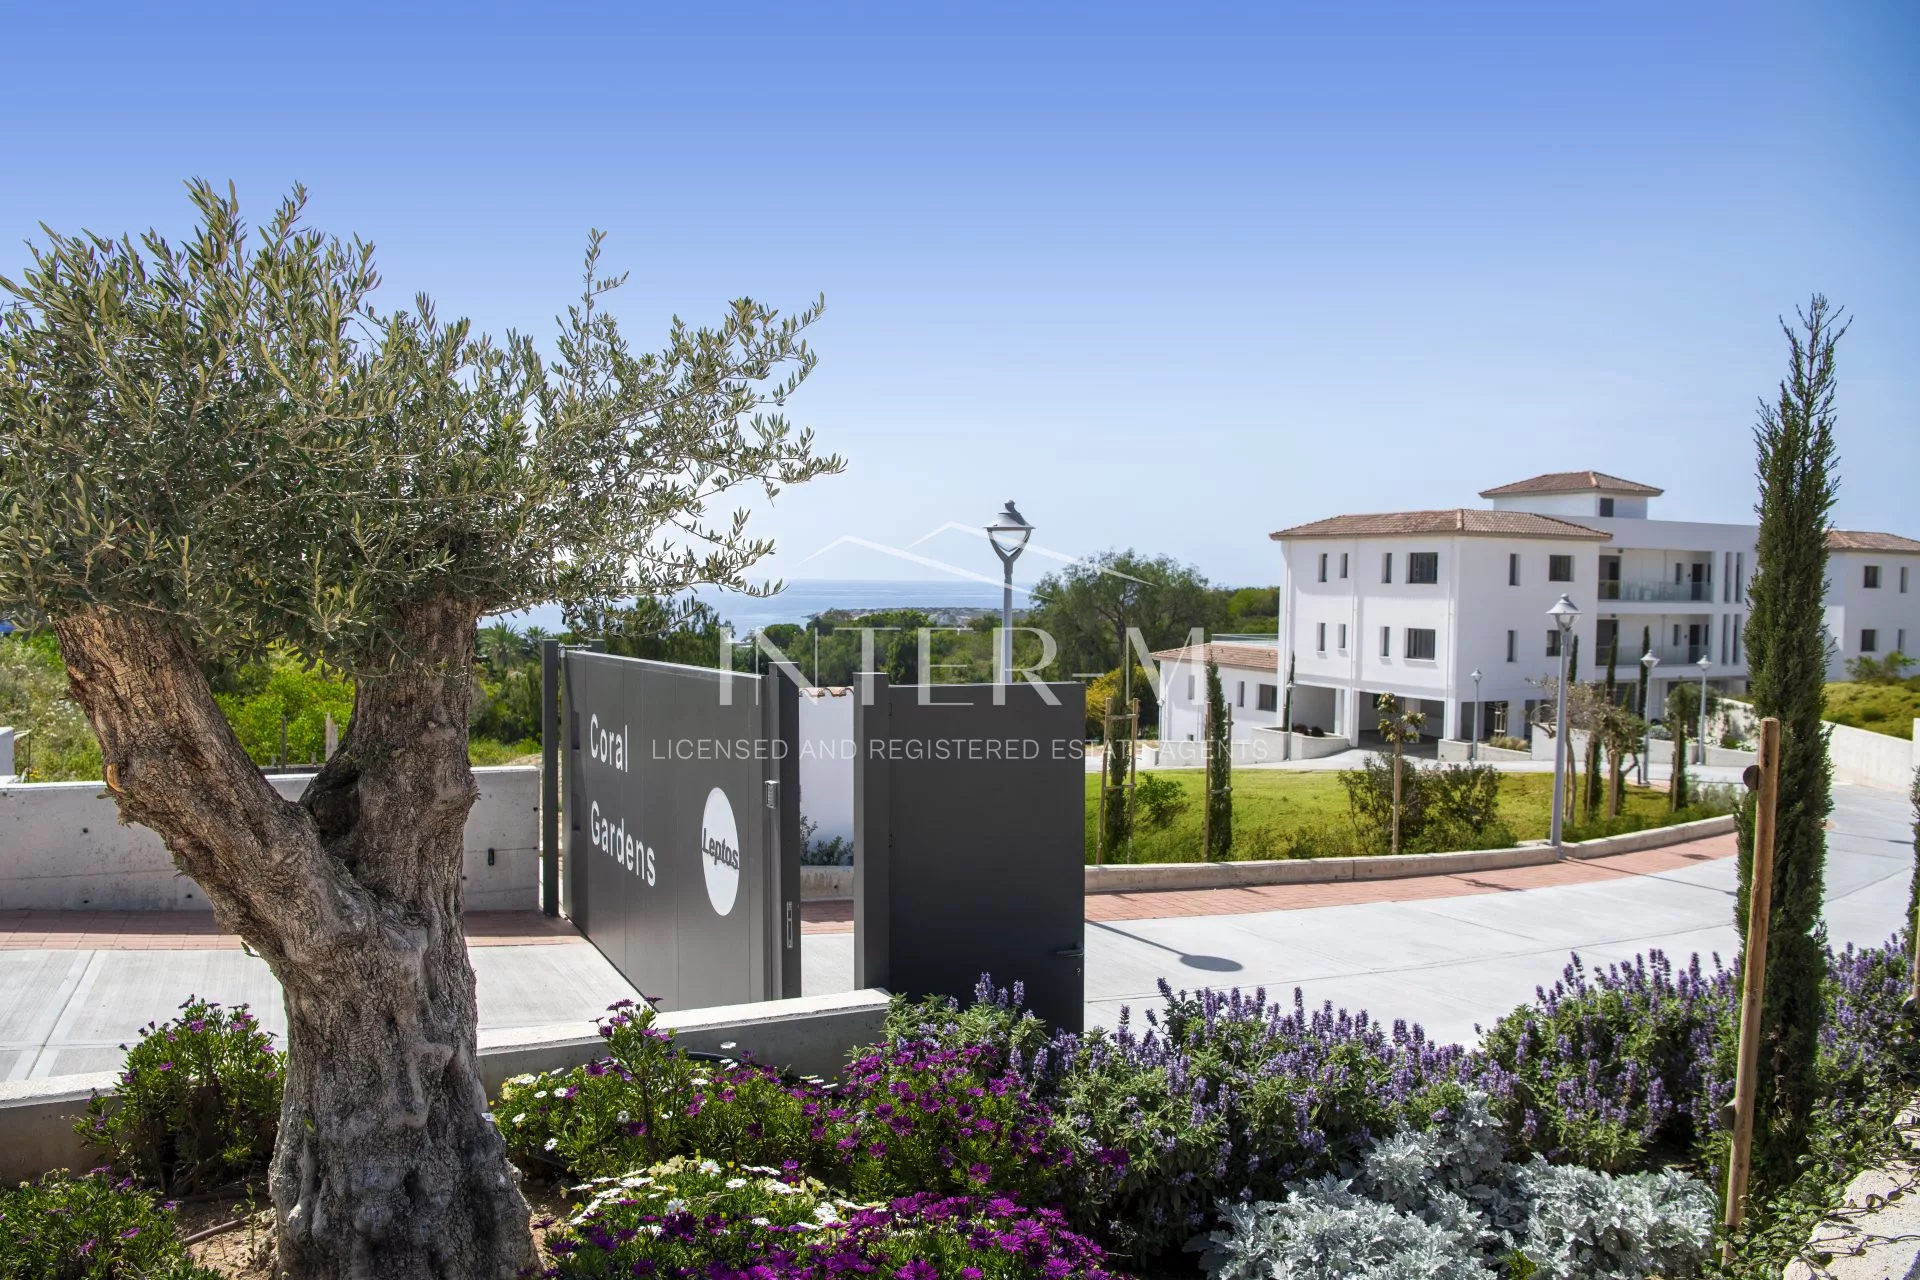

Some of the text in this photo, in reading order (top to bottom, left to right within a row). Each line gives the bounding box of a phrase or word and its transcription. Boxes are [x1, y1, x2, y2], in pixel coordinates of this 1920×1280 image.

[590, 713, 628, 773] Coral
[590, 800, 656, 887] Gardens
[702, 828, 739, 870] Leptos
